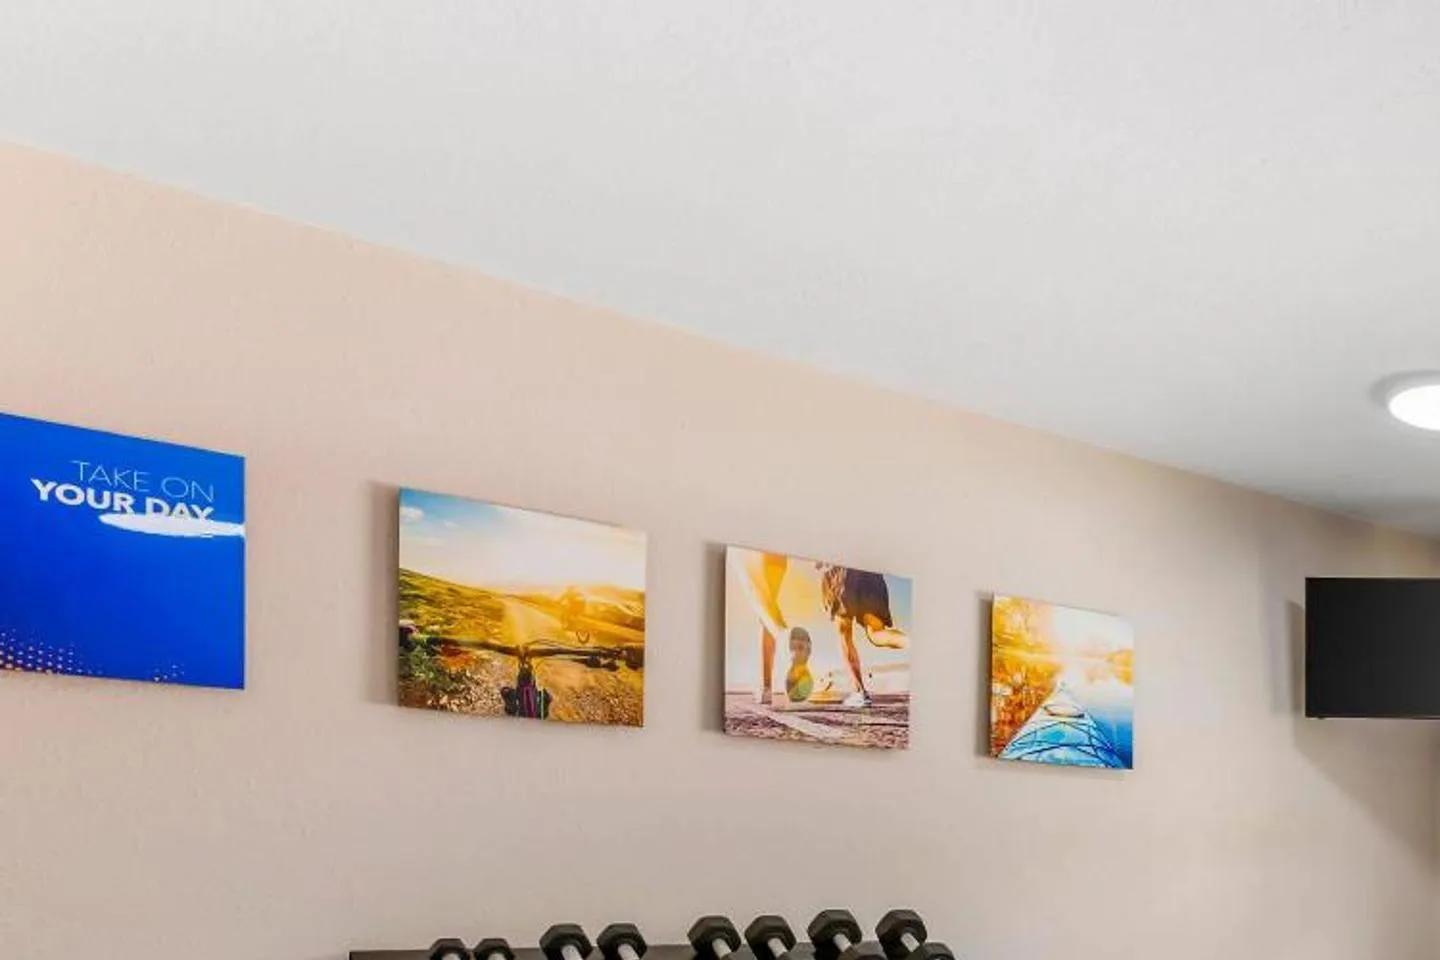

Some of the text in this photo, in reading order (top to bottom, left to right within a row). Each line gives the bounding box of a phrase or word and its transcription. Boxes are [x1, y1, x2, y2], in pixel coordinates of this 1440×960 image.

[31, 478, 215, 521] YOUR DAY
[71, 460, 214, 503] TAKE ON
